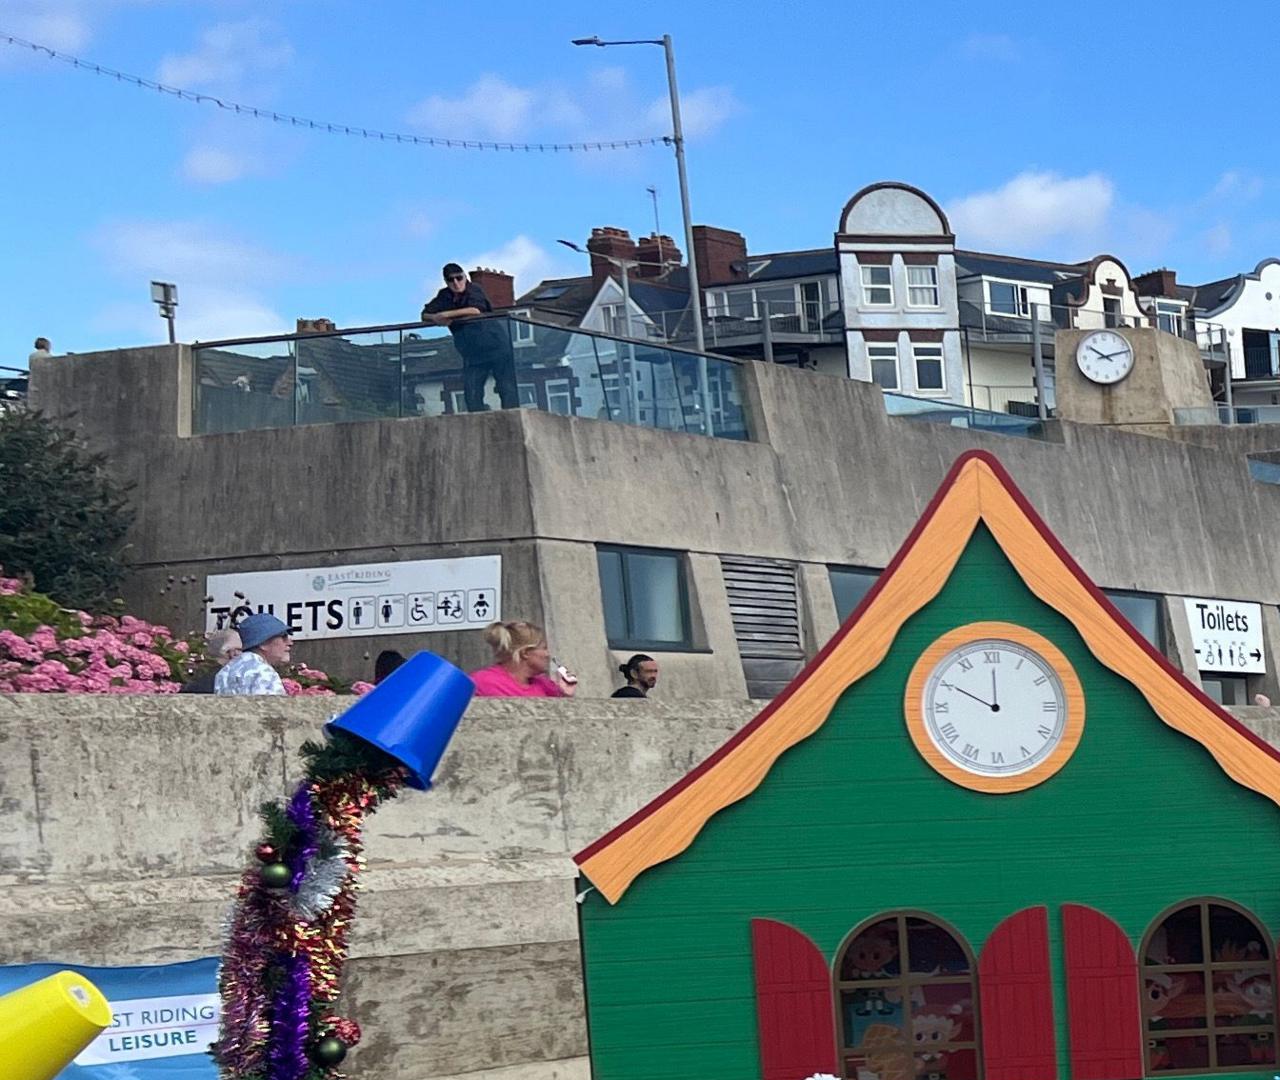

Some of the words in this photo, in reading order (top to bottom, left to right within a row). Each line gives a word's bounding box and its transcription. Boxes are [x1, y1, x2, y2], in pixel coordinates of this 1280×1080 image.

[1195, 603, 1249, 633] Toilets
[984, 651, 1001, 664] XII
[141, 1005, 216, 1026] RIDING
[108, 1029, 198, 1053] LEISURE
